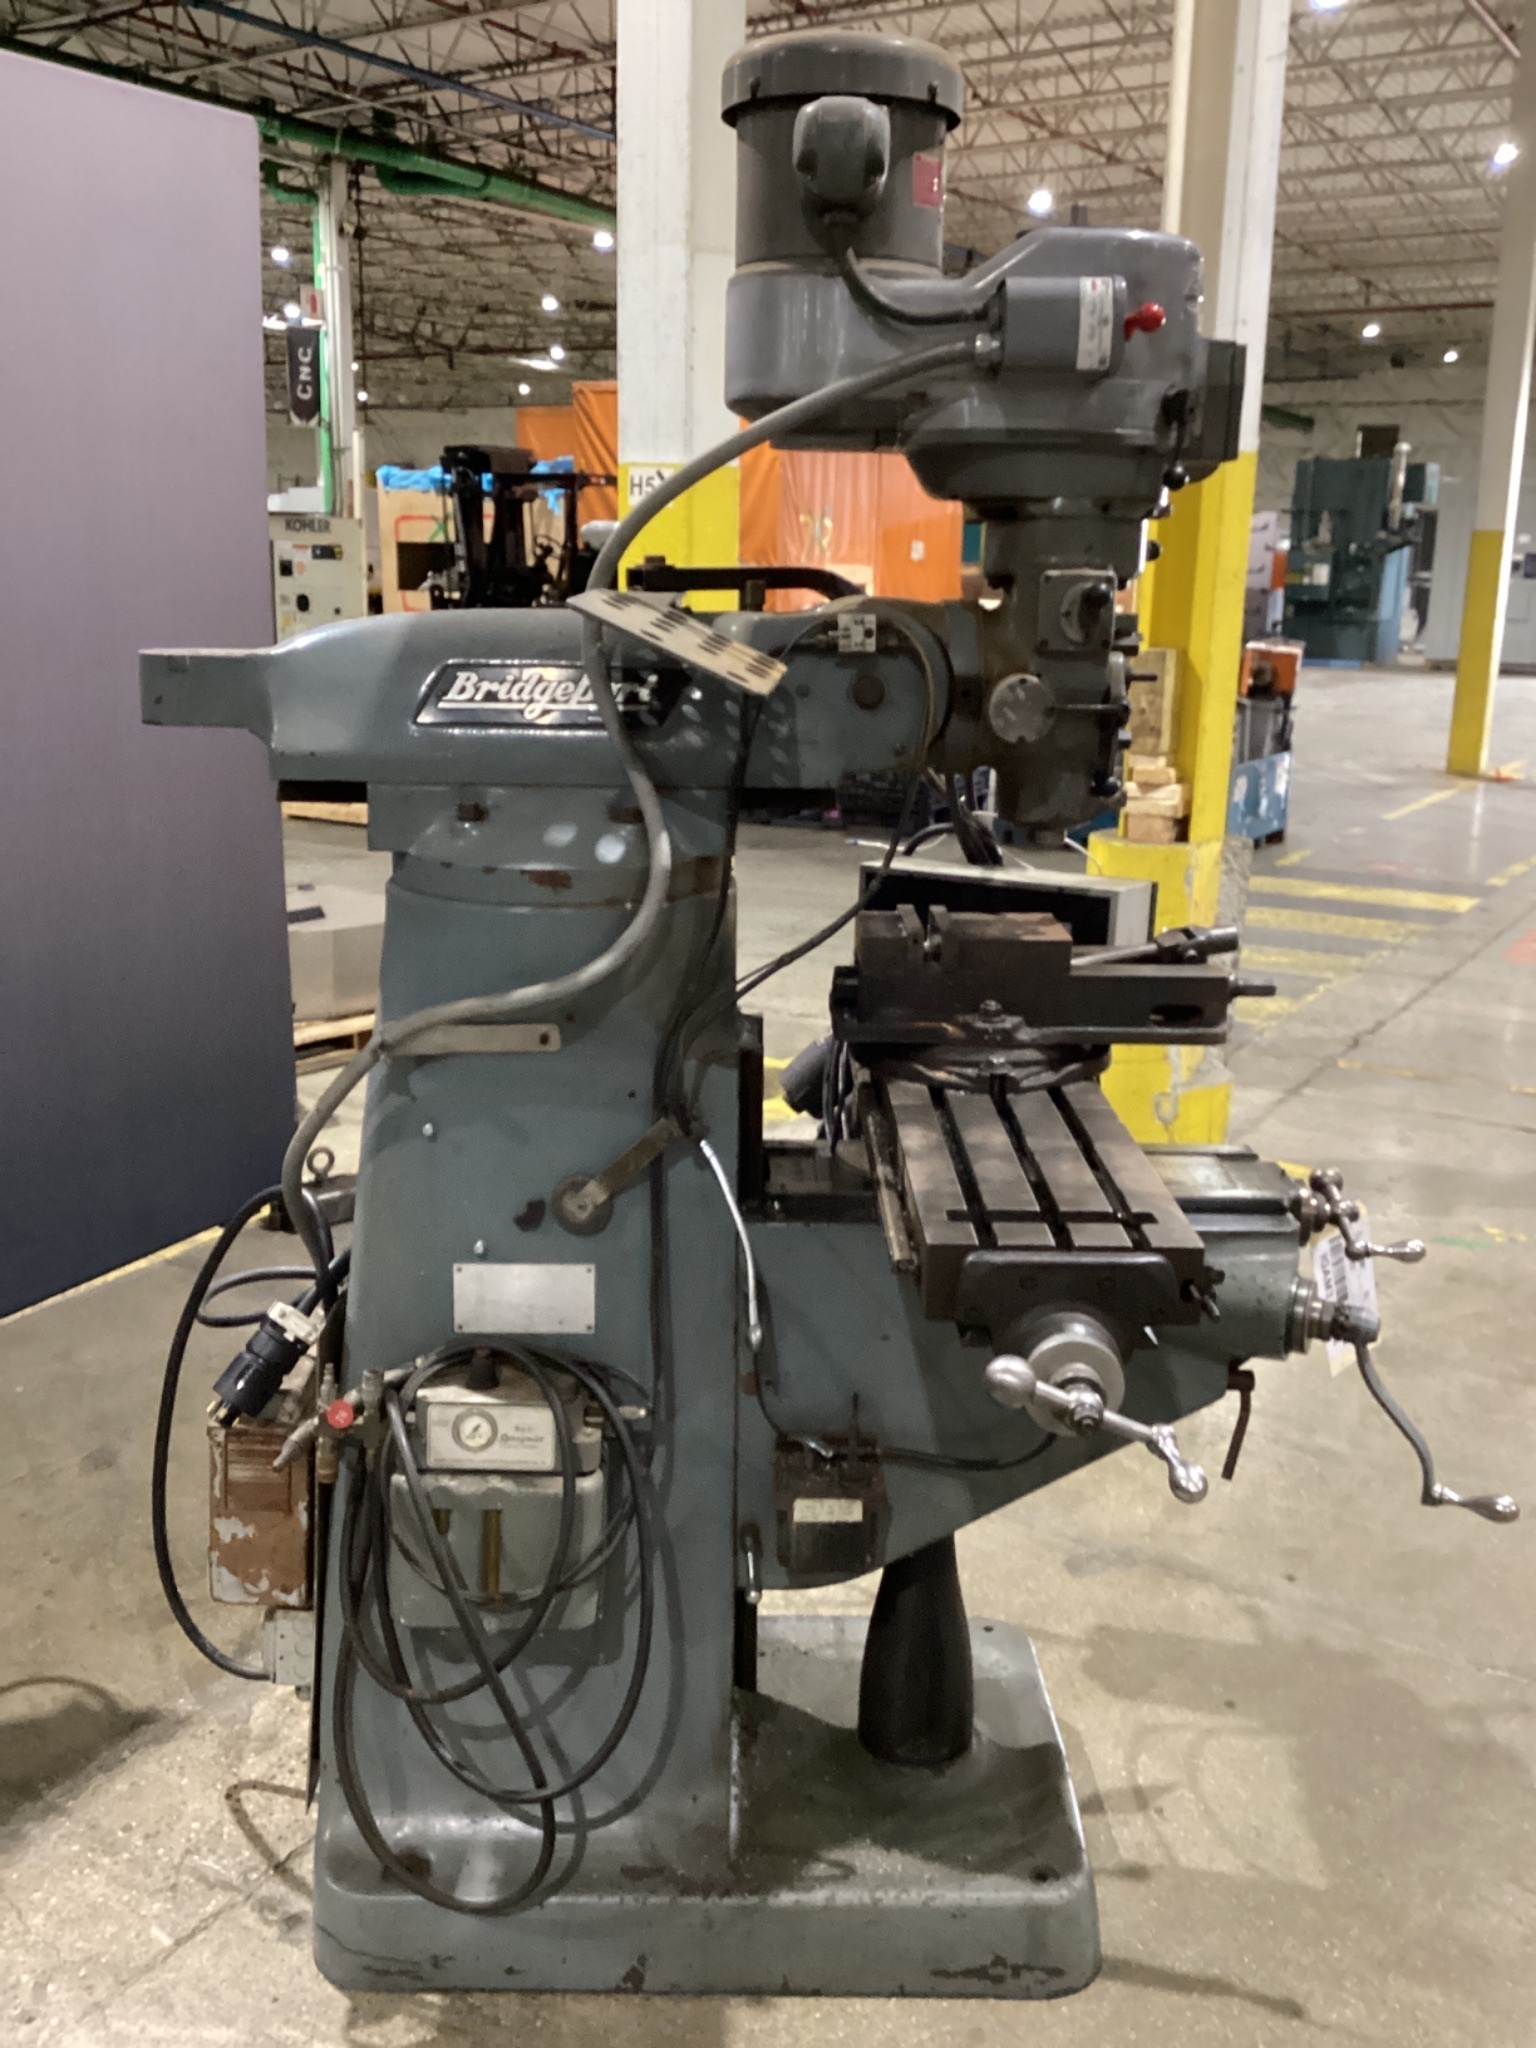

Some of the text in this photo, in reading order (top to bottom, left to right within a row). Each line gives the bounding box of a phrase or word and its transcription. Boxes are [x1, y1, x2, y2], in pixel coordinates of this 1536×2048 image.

[296, 346, 312, 401] CNC
[284, 518, 331, 533] KOHLER
[441, 671, 659, 720] Bridgeprt
